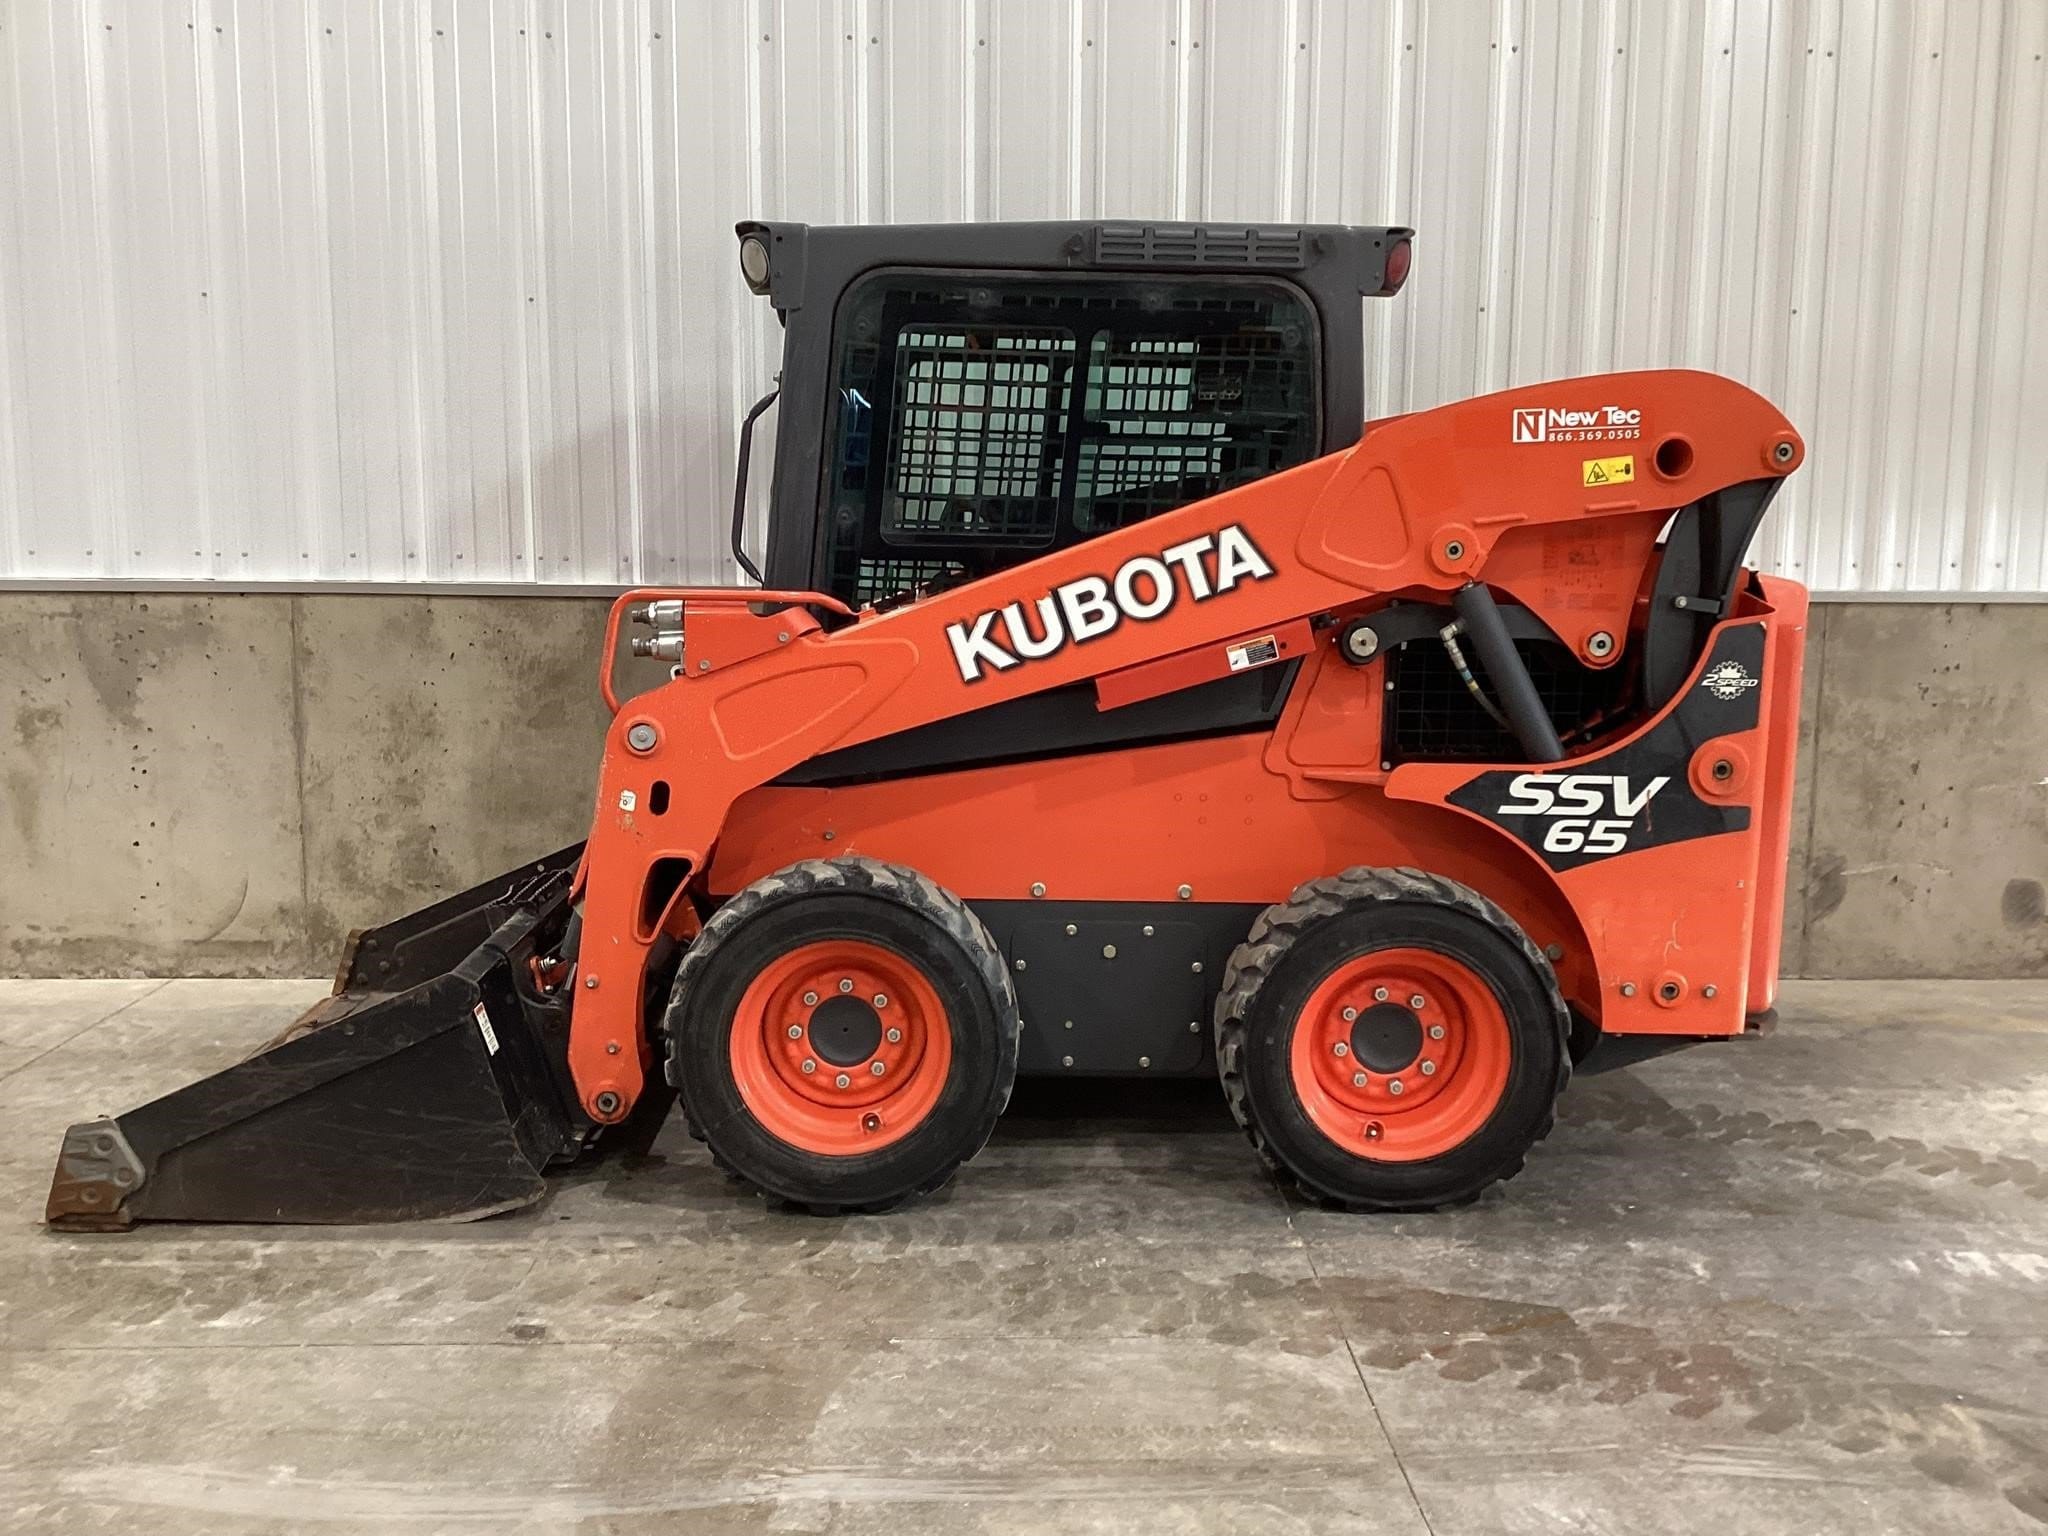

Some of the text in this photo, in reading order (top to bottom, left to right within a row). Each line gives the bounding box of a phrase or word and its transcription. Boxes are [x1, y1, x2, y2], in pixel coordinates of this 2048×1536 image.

[1549, 406, 1640, 427] New Tec
[1548, 429, 1641, 442] 866.369.0505
[946, 524, 1275, 683] KUBOTA
[1497, 774, 1671, 817] SSV
[1543, 819, 1633, 853] 65
